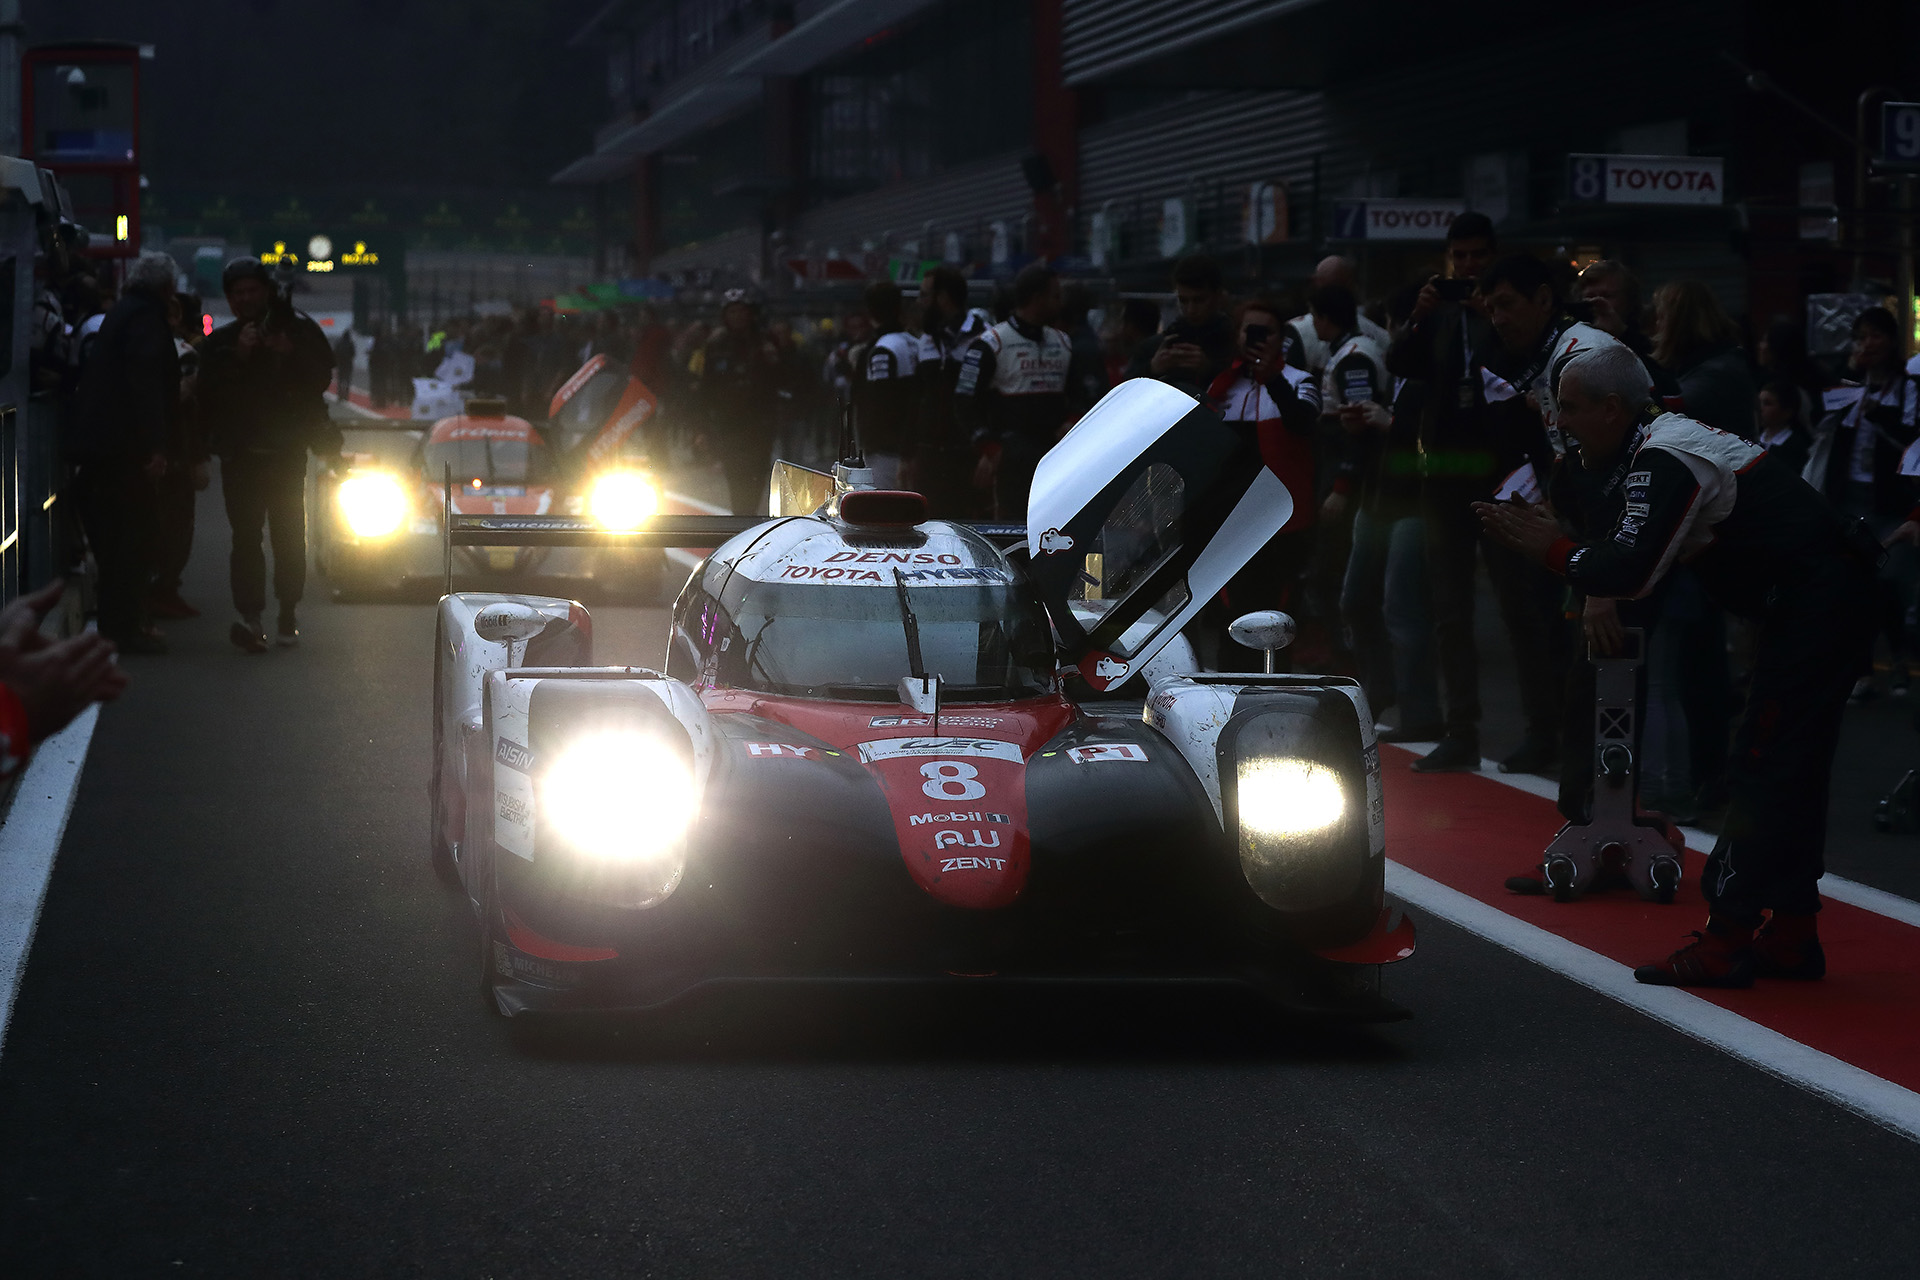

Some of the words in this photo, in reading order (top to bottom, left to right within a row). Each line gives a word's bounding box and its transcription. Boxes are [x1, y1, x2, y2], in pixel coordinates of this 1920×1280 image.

[1896, 107, 1920, 157] 9
[1575, 159, 1600, 198] 8
[1612, 169, 1717, 191] TOYOTA
[1338, 205, 1356, 237] 7
[1372, 210, 1457, 229] TOYOTA
[260, 253, 299, 265] ROLX
[824, 551, 962, 565] DENSO
[780, 565, 882, 582] TOYOTA
[901, 566, 1008, 582] HYBRID
[871, 716, 931, 726] GR
[747, 743, 813, 757] HY
[900, 740, 1000, 751] WEC
[1078, 746, 1134, 759] P1
[497, 743, 535, 770] AISIN
[919, 760, 987, 801] 8
[909, 811, 982, 827] Mobil
[940, 856, 1007, 873] ZENT
